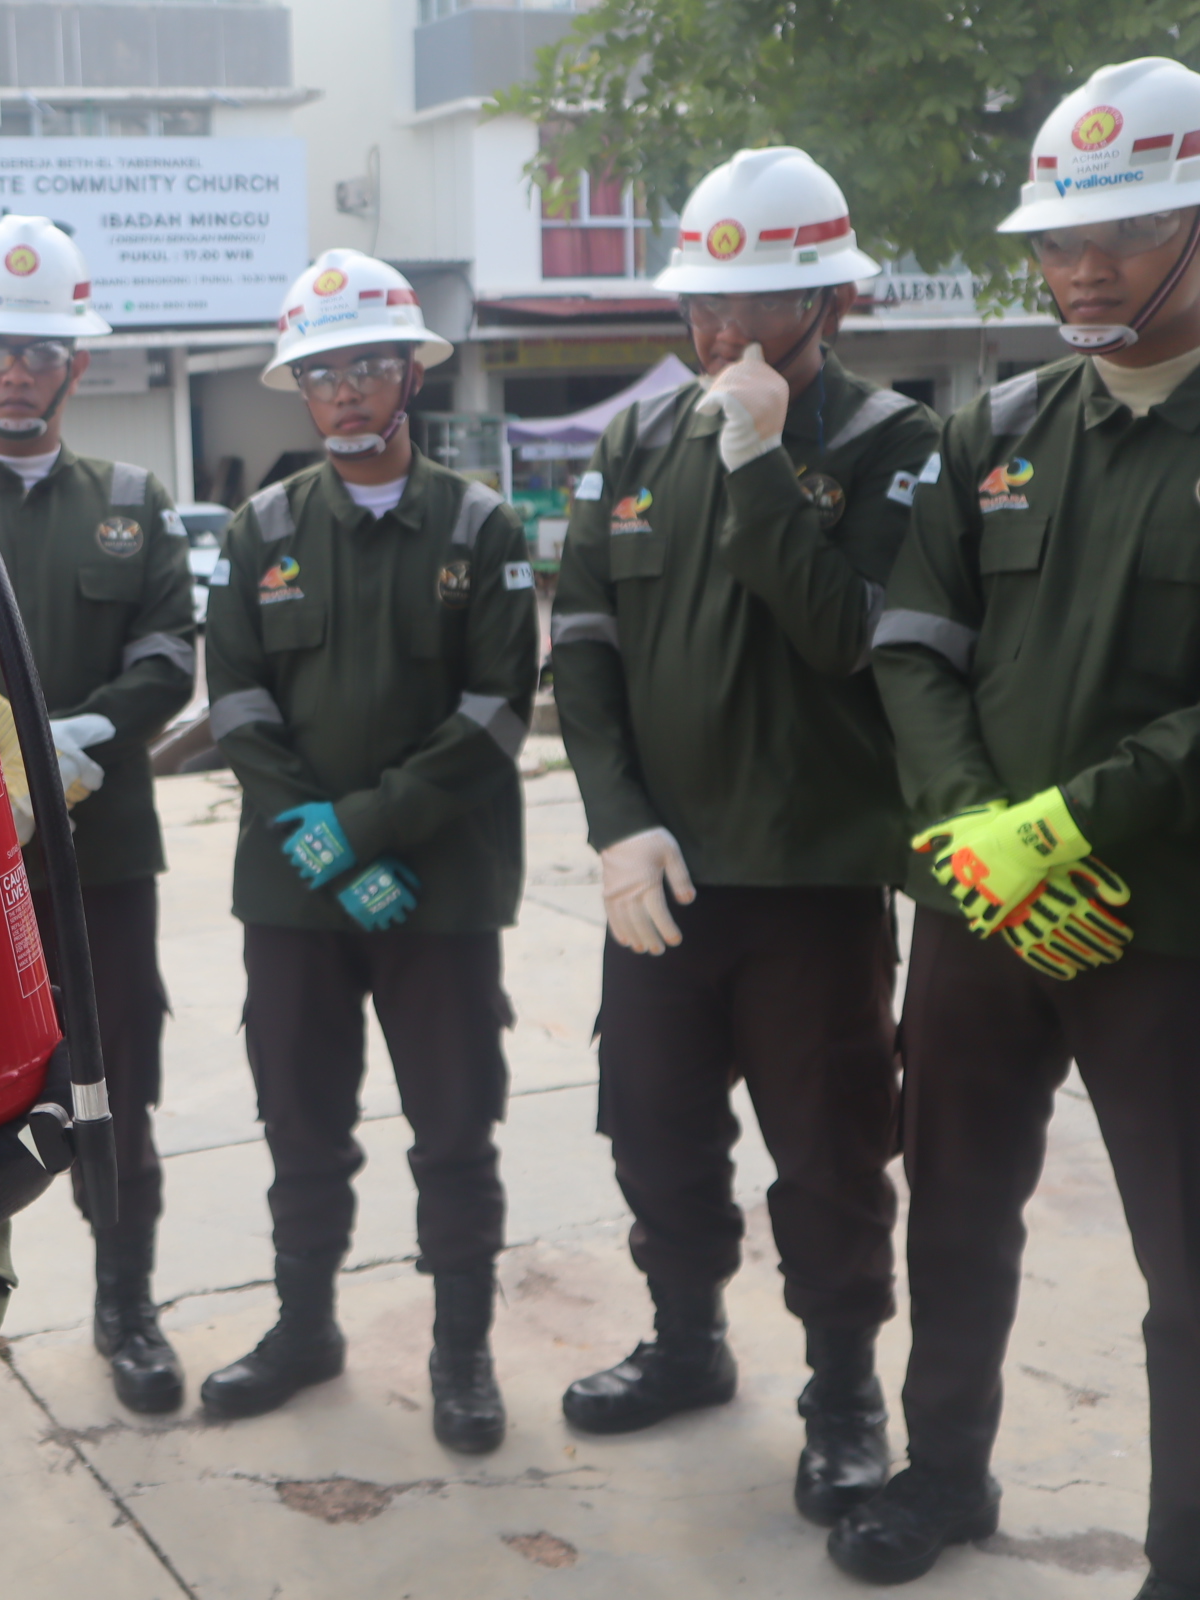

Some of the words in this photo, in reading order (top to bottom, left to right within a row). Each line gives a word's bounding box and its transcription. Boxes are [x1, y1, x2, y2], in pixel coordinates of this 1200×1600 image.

[0, 157, 52, 169] GEREJA
[120, 156, 203, 168] TABERNAKEL
[1072, 150, 1120, 164] ACHMAD
[1077, 162, 1110, 175] HANIF
[35, 174, 176, 194] COMMUNITY
[186, 174, 280, 193] CHURCH
[1075, 170, 1144, 190] vallourec
[101, 212, 181, 228] IBADAH
[189, 211, 270, 227] MINGGU
[119, 250, 168, 262] PUKUL
[225, 249, 255, 261] WIB
[885, 280, 964, 301] ALESYA
[312, 310, 359, 328] vallourec
[6, 883, 24, 906] LIVE
